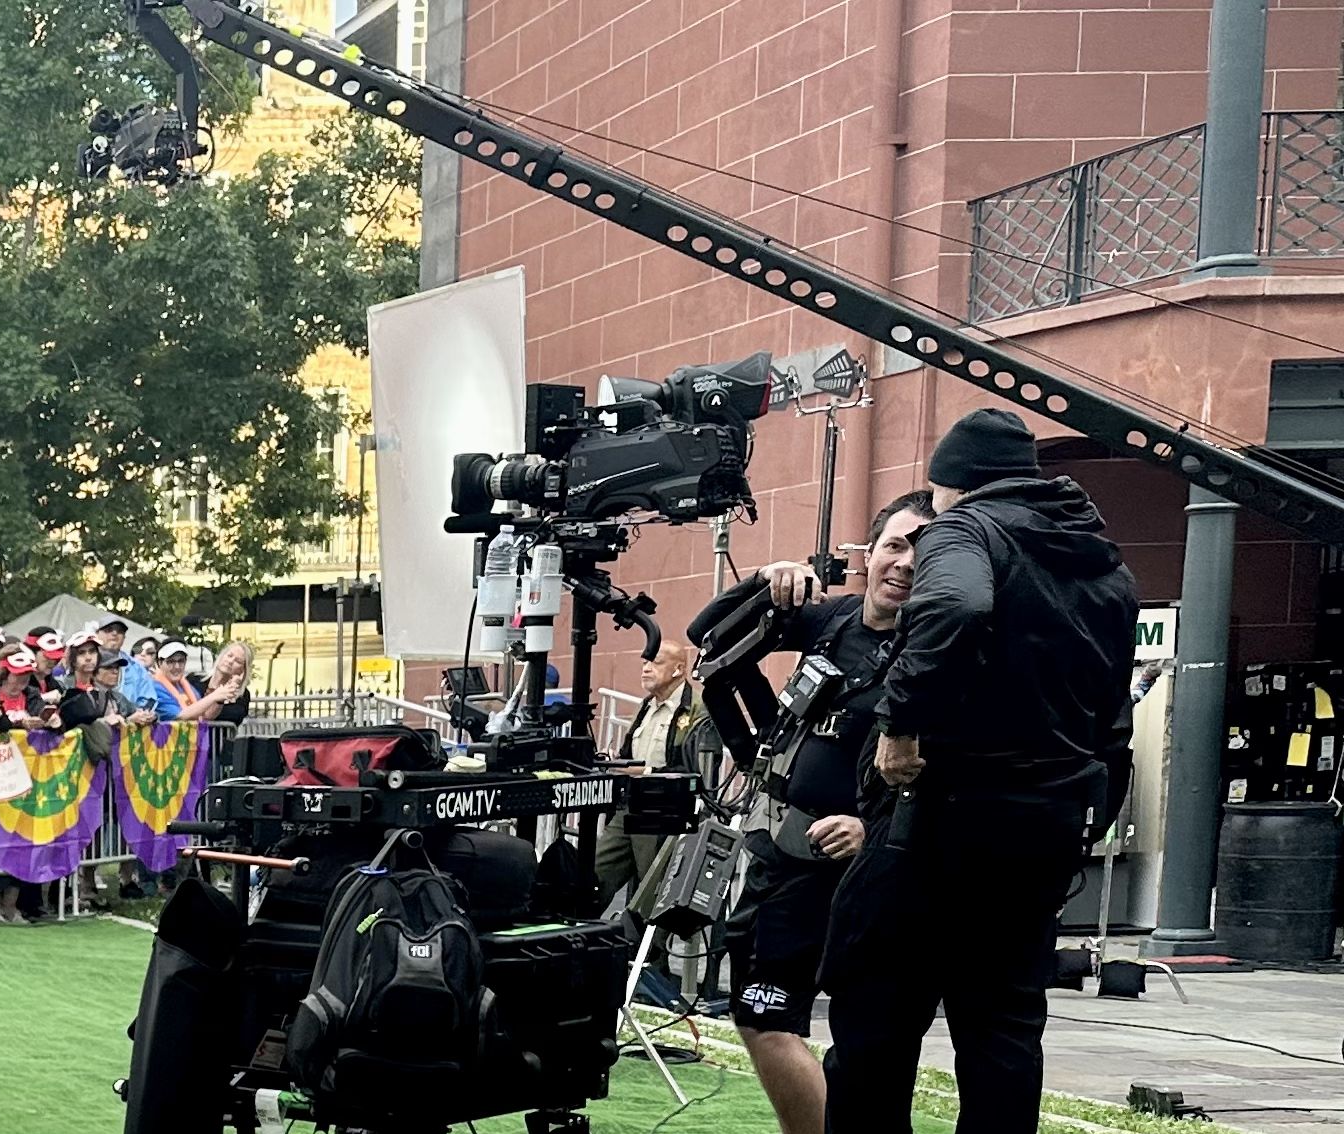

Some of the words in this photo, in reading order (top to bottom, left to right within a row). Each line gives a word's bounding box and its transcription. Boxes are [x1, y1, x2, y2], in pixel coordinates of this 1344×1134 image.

[436, 789, 496, 819] GCAM.TV
[554, 779, 614, 809] STEADICAM
[742, 988, 787, 1005] SNF
